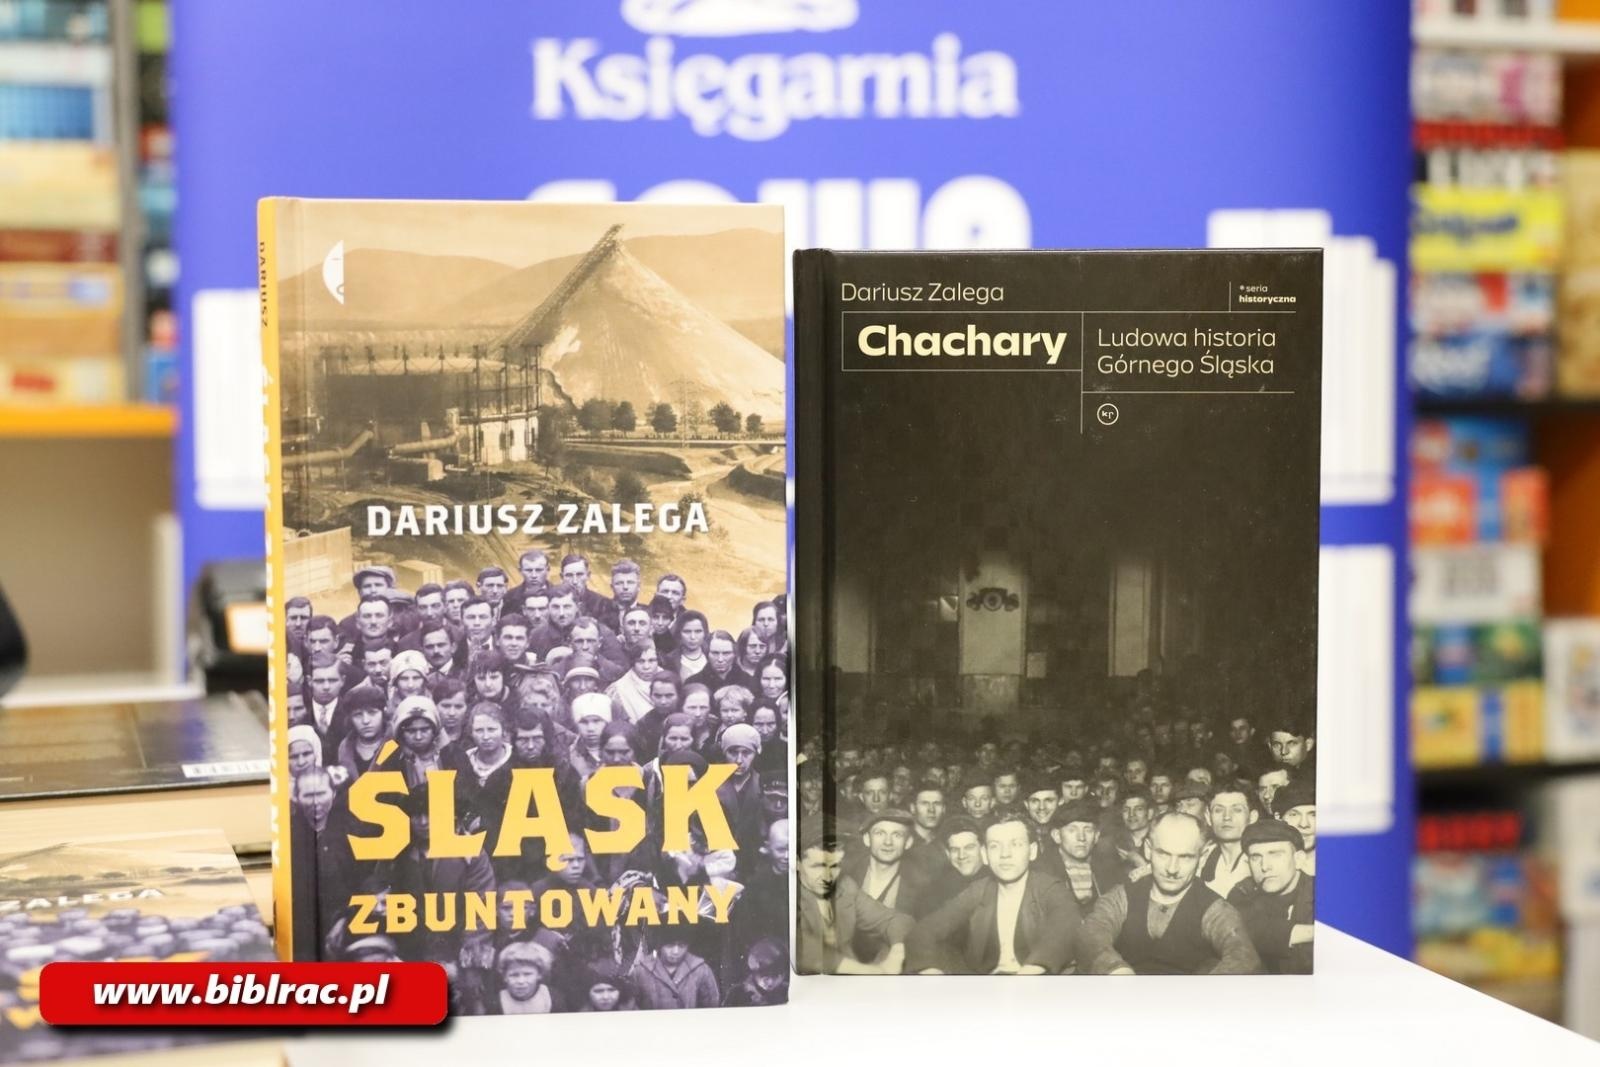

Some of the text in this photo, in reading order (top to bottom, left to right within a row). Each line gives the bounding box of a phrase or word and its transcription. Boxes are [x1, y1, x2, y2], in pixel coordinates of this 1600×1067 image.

[532, 32, 1020, 141] Księgarnia
[841, 282, 1004, 305] Dariusz Zalega
[1238, 294, 1297, 305] historyczna
[1246, 284, 1268, 293] seria
[857, 324, 1068, 365] Chachary
[1098, 327, 1276, 347] Ludowa historia
[1097, 350, 1275, 379] Górnego Śląska
[367, 503, 709, 536] DARIUSZ ZALEGA
[346, 739, 740, 872] ŚLĄSK
[347, 884, 740, 935] ZBUNTOWANY
